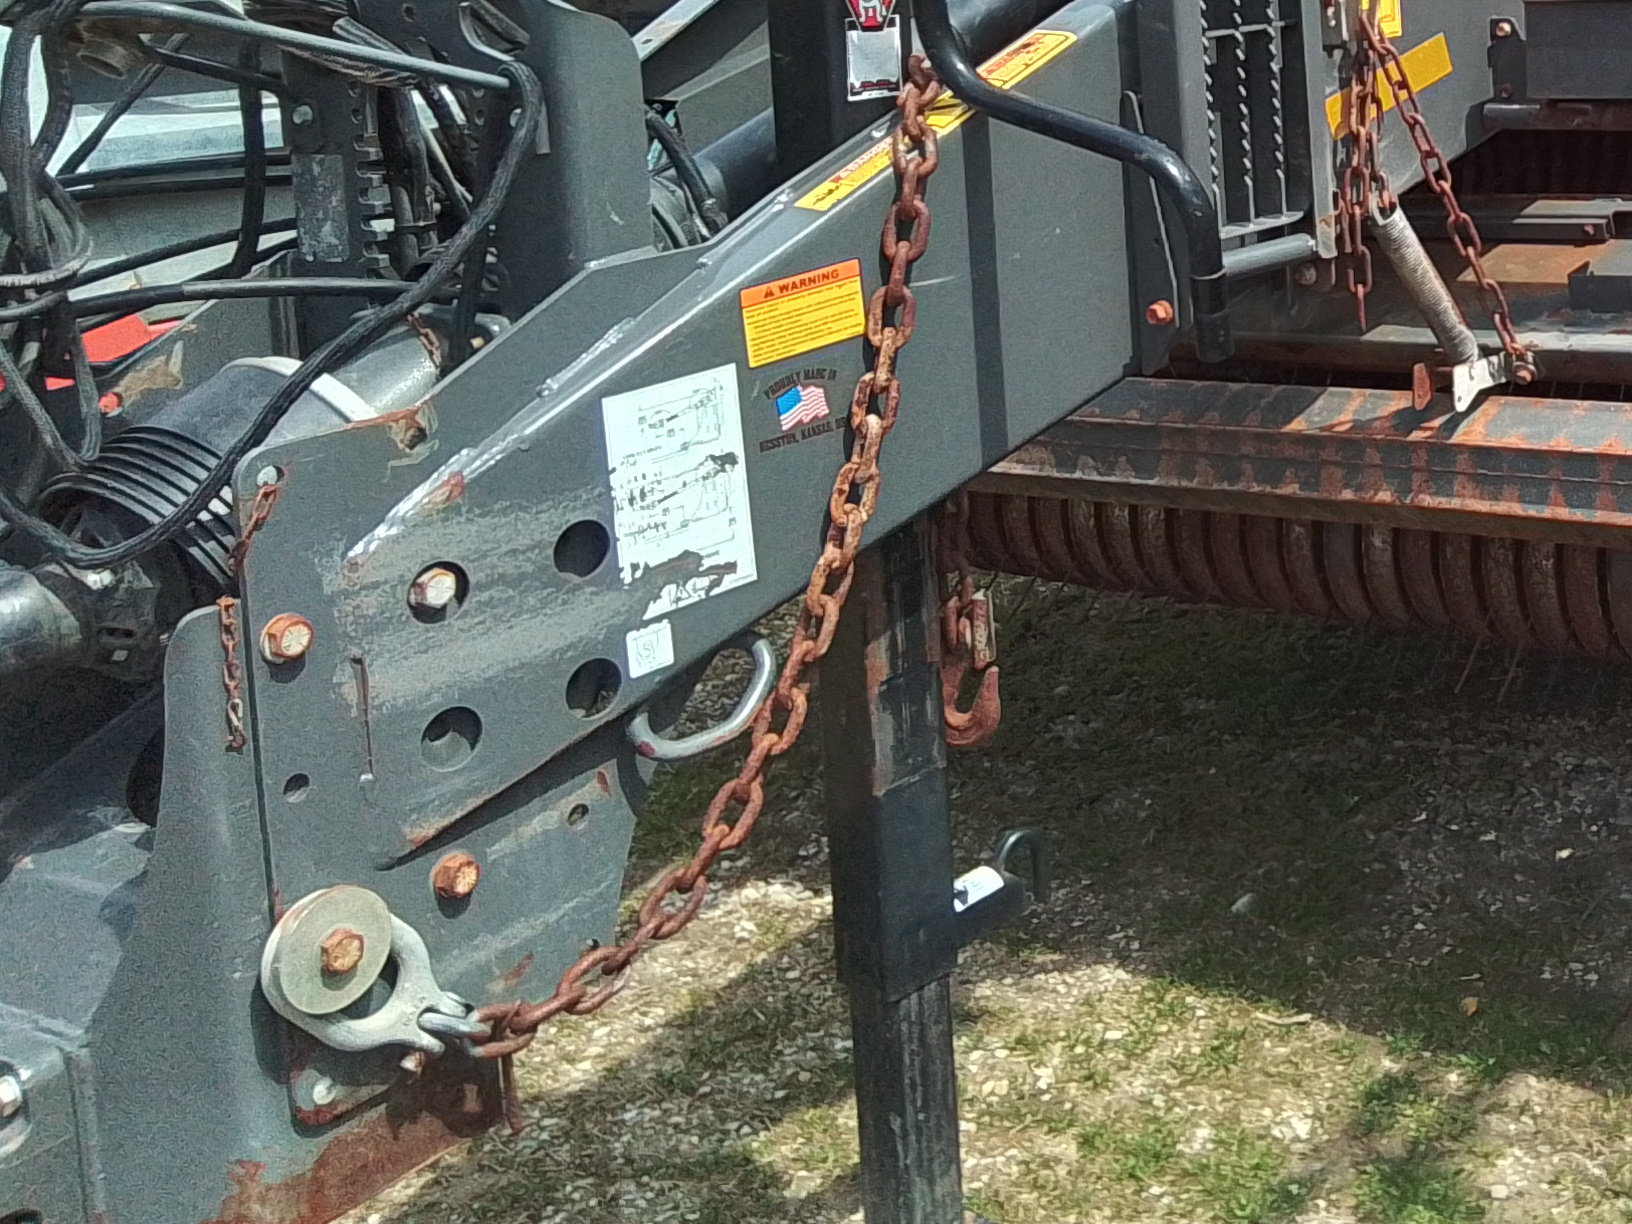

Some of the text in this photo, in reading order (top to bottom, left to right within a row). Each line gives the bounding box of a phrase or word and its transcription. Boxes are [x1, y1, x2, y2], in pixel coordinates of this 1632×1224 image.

[778, 269, 840, 294] WARNING
[764, 370, 801, 400] PROUDLY
[803, 368, 827, 381] MADE
